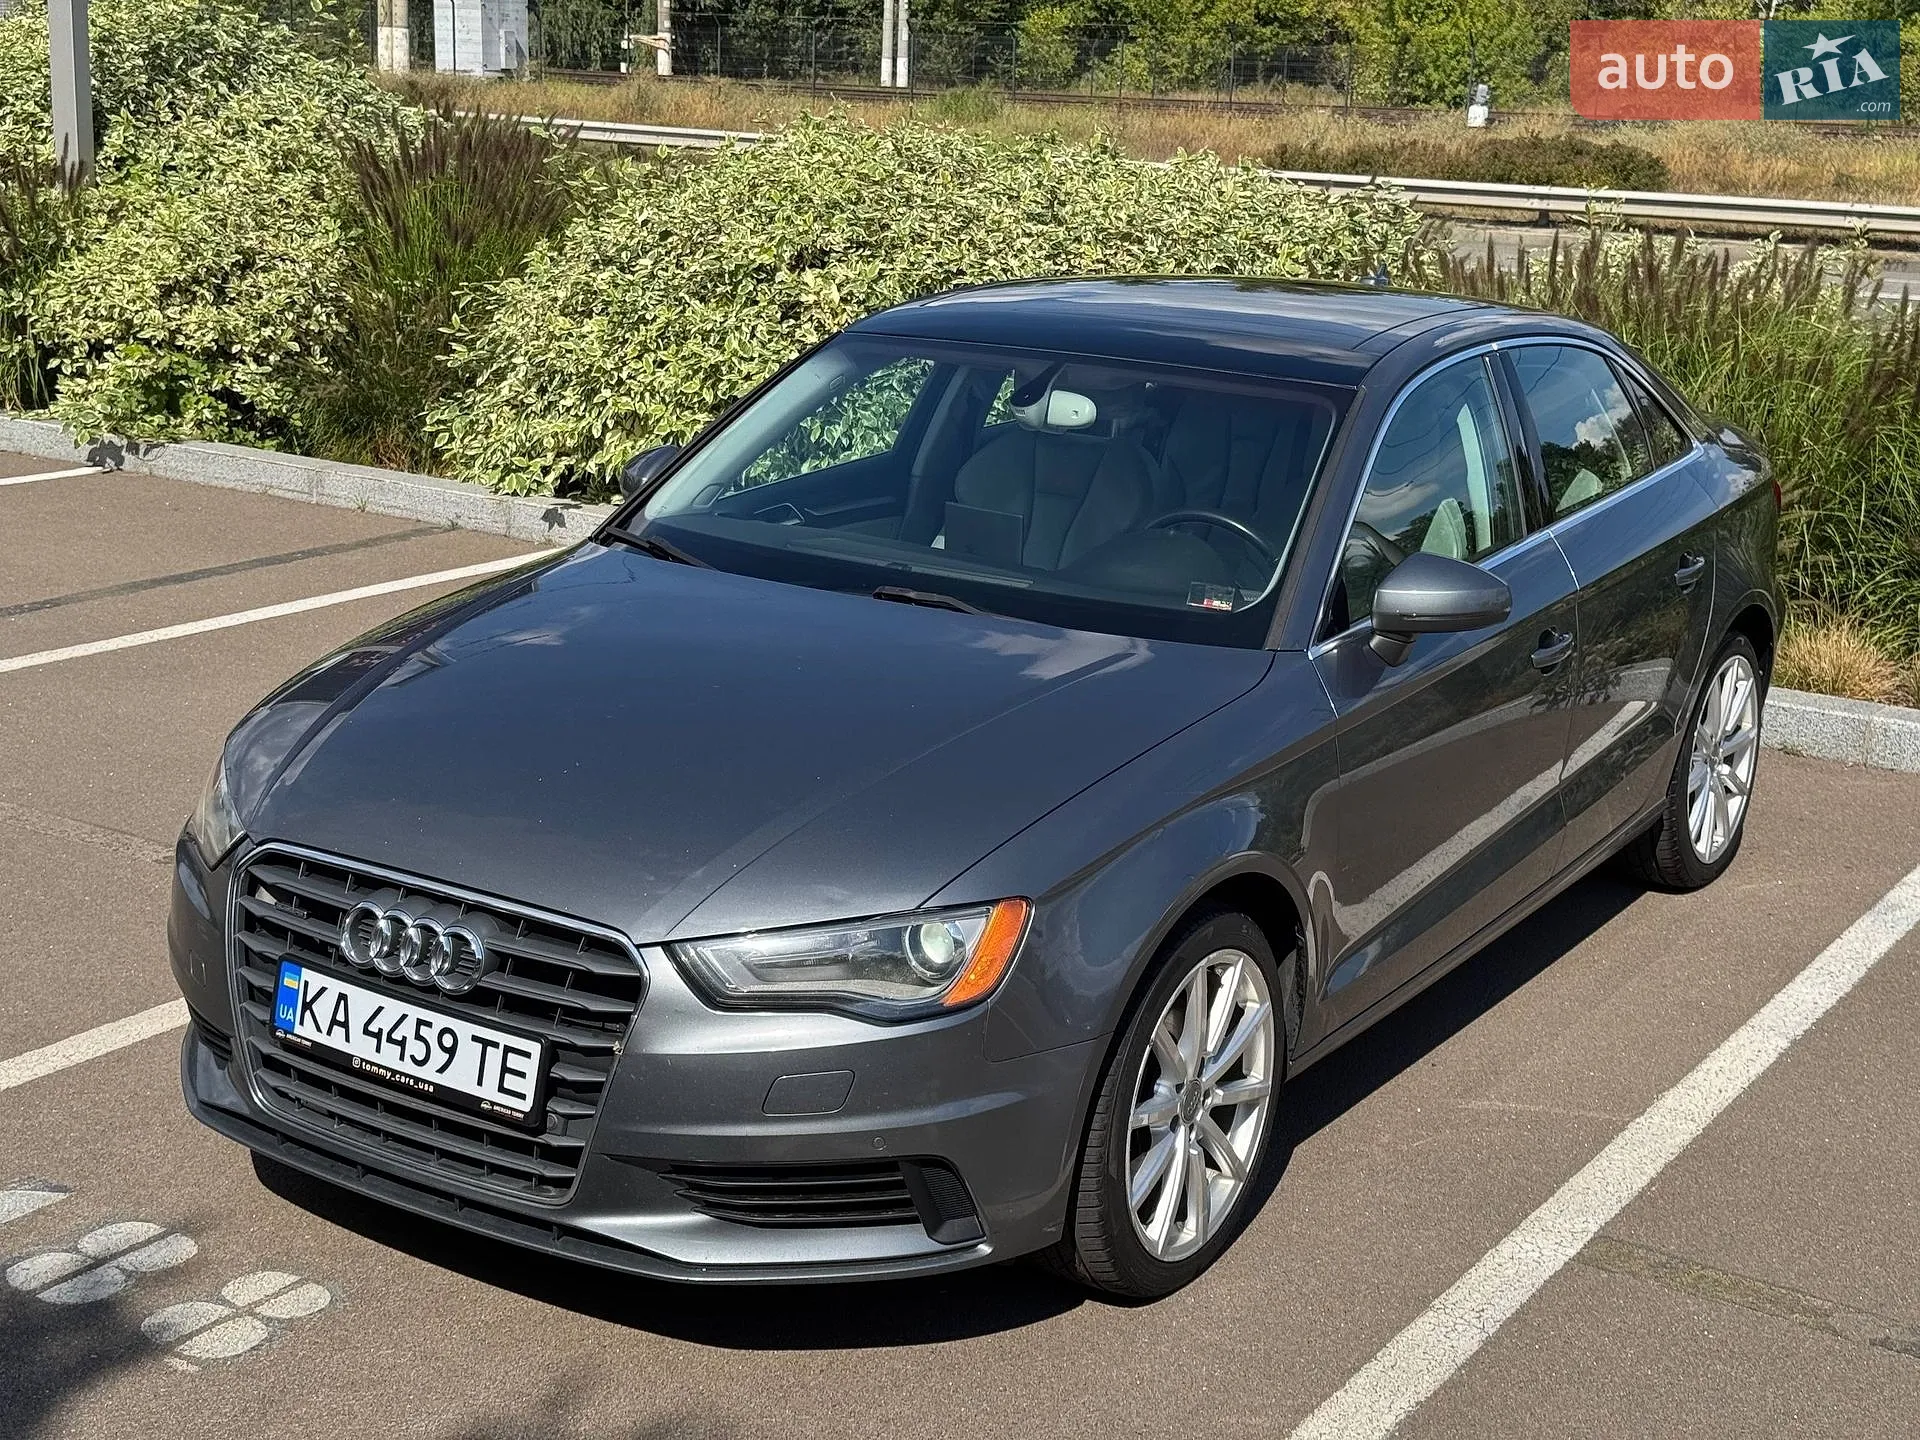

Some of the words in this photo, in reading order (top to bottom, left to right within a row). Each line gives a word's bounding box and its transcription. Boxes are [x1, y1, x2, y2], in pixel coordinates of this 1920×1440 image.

[279, 1004, 295, 1023] UA
[298, 980, 351, 1043] KA
[362, 1006, 459, 1075] 4459
[471, 1034, 532, 1102] TE
[361, 1061, 434, 1093] tommy_cars_usa
